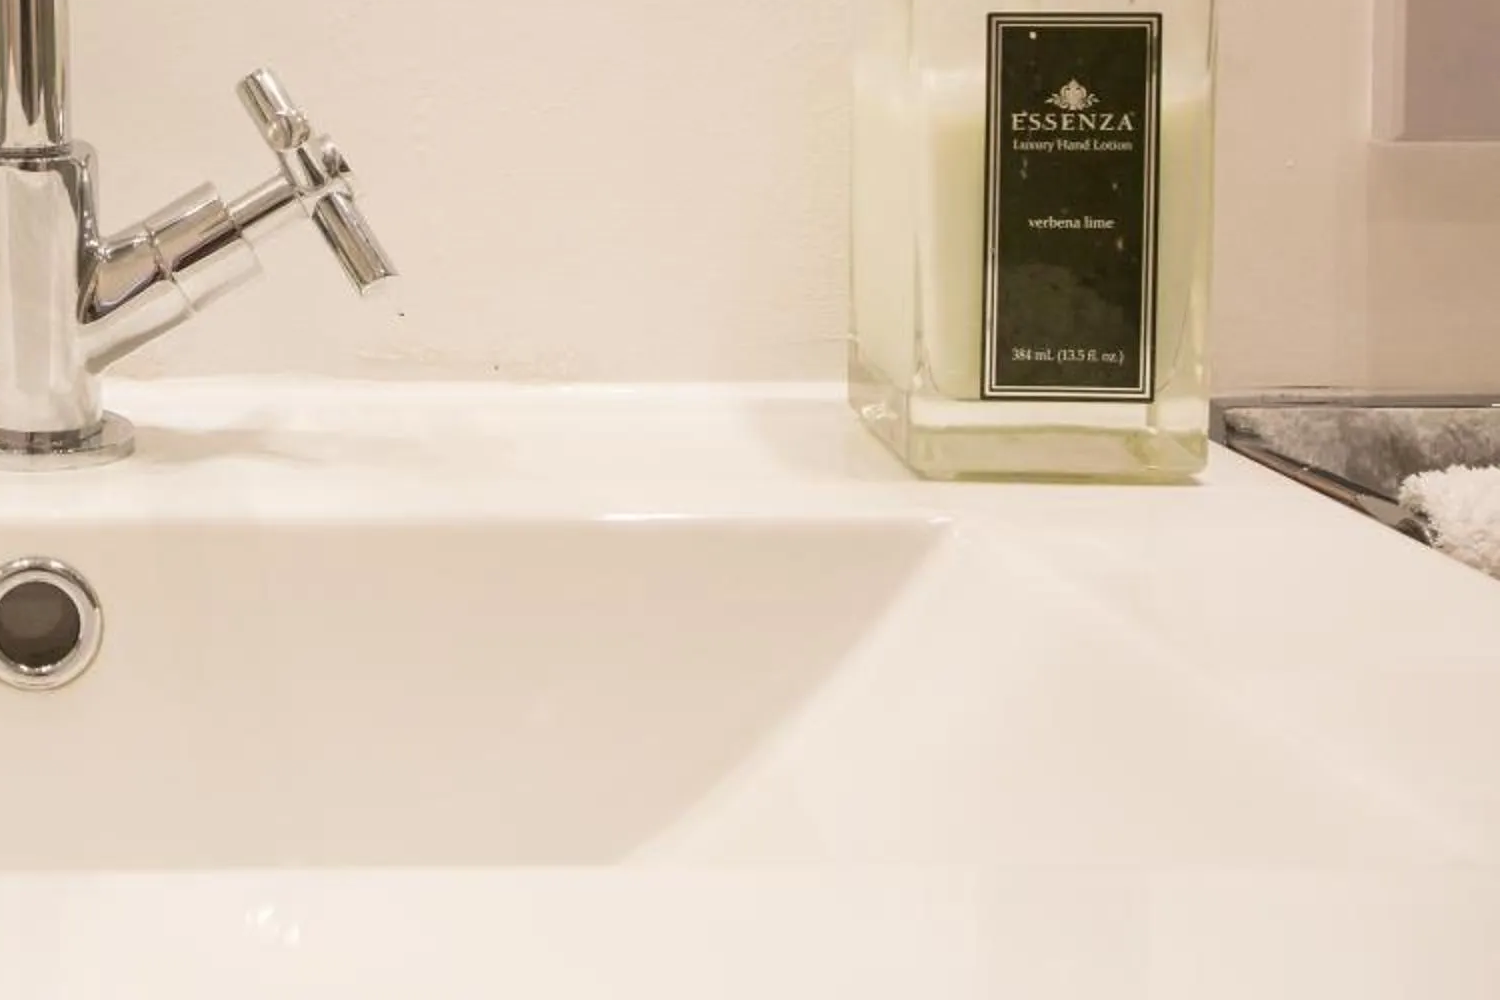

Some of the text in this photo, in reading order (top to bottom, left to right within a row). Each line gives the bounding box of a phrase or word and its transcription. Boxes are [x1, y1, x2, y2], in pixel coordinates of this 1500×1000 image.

[1011, 112, 1133, 131] ESSENZA
[1013, 139, 1133, 152] Luxury Hand Lotion
[1028, 216, 1115, 229] verbena lime
